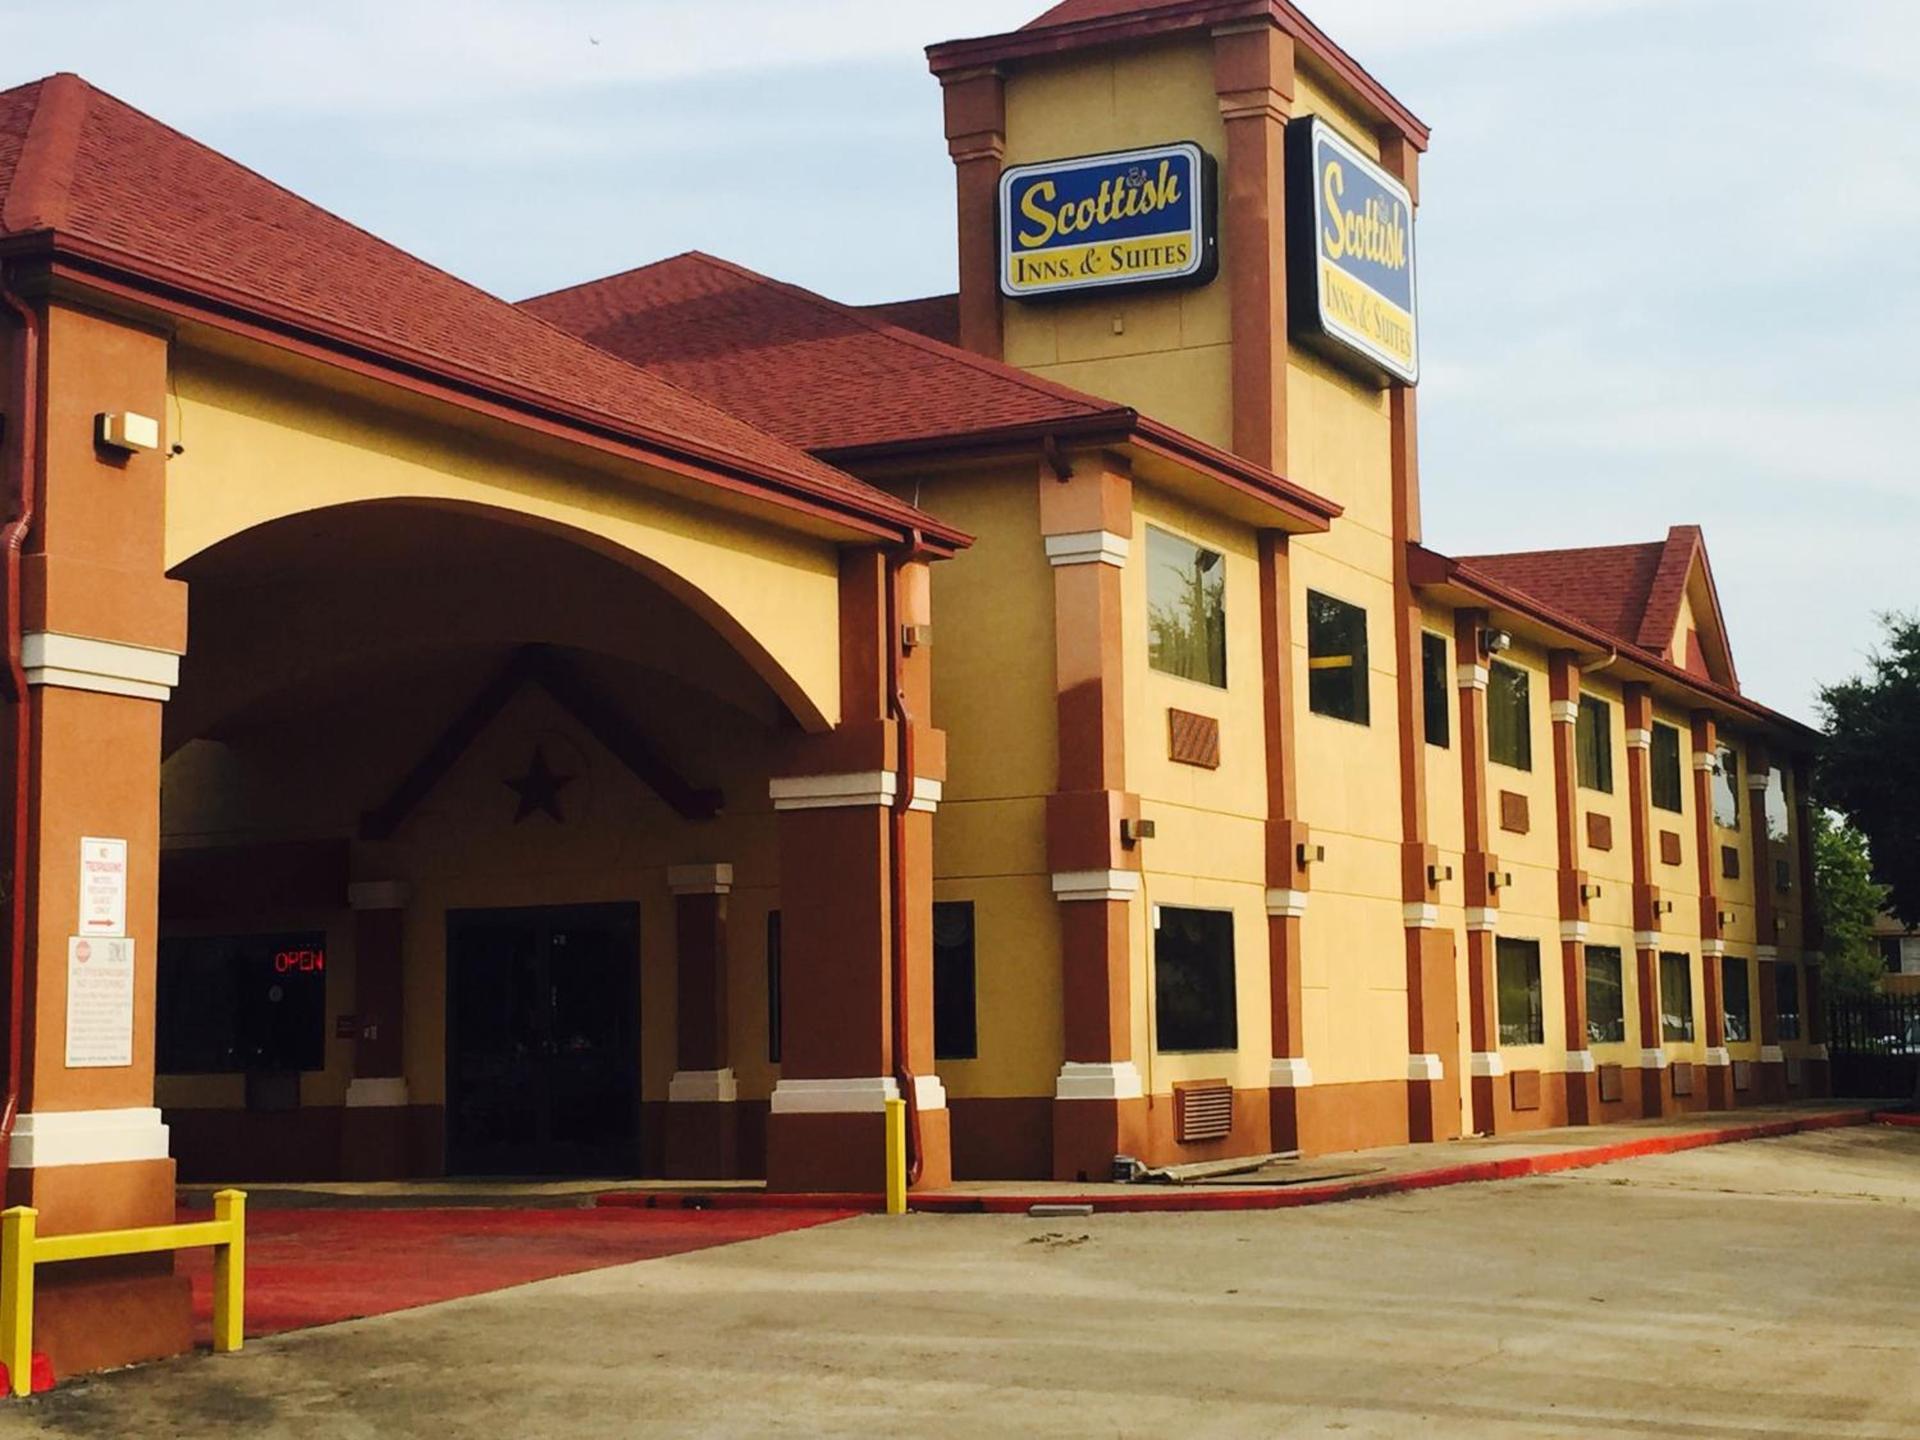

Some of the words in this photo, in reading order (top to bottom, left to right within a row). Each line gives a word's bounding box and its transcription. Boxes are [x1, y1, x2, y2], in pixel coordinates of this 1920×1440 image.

[1018, 160, 1181, 247] Scottish
[1324, 160, 1406, 271] Scottish
[1081, 248, 1101, 275] &
[1110, 244, 1187, 271] SUITES
[1374, 300, 1411, 357] SUITES
[274, 951, 324, 972] OPEN
